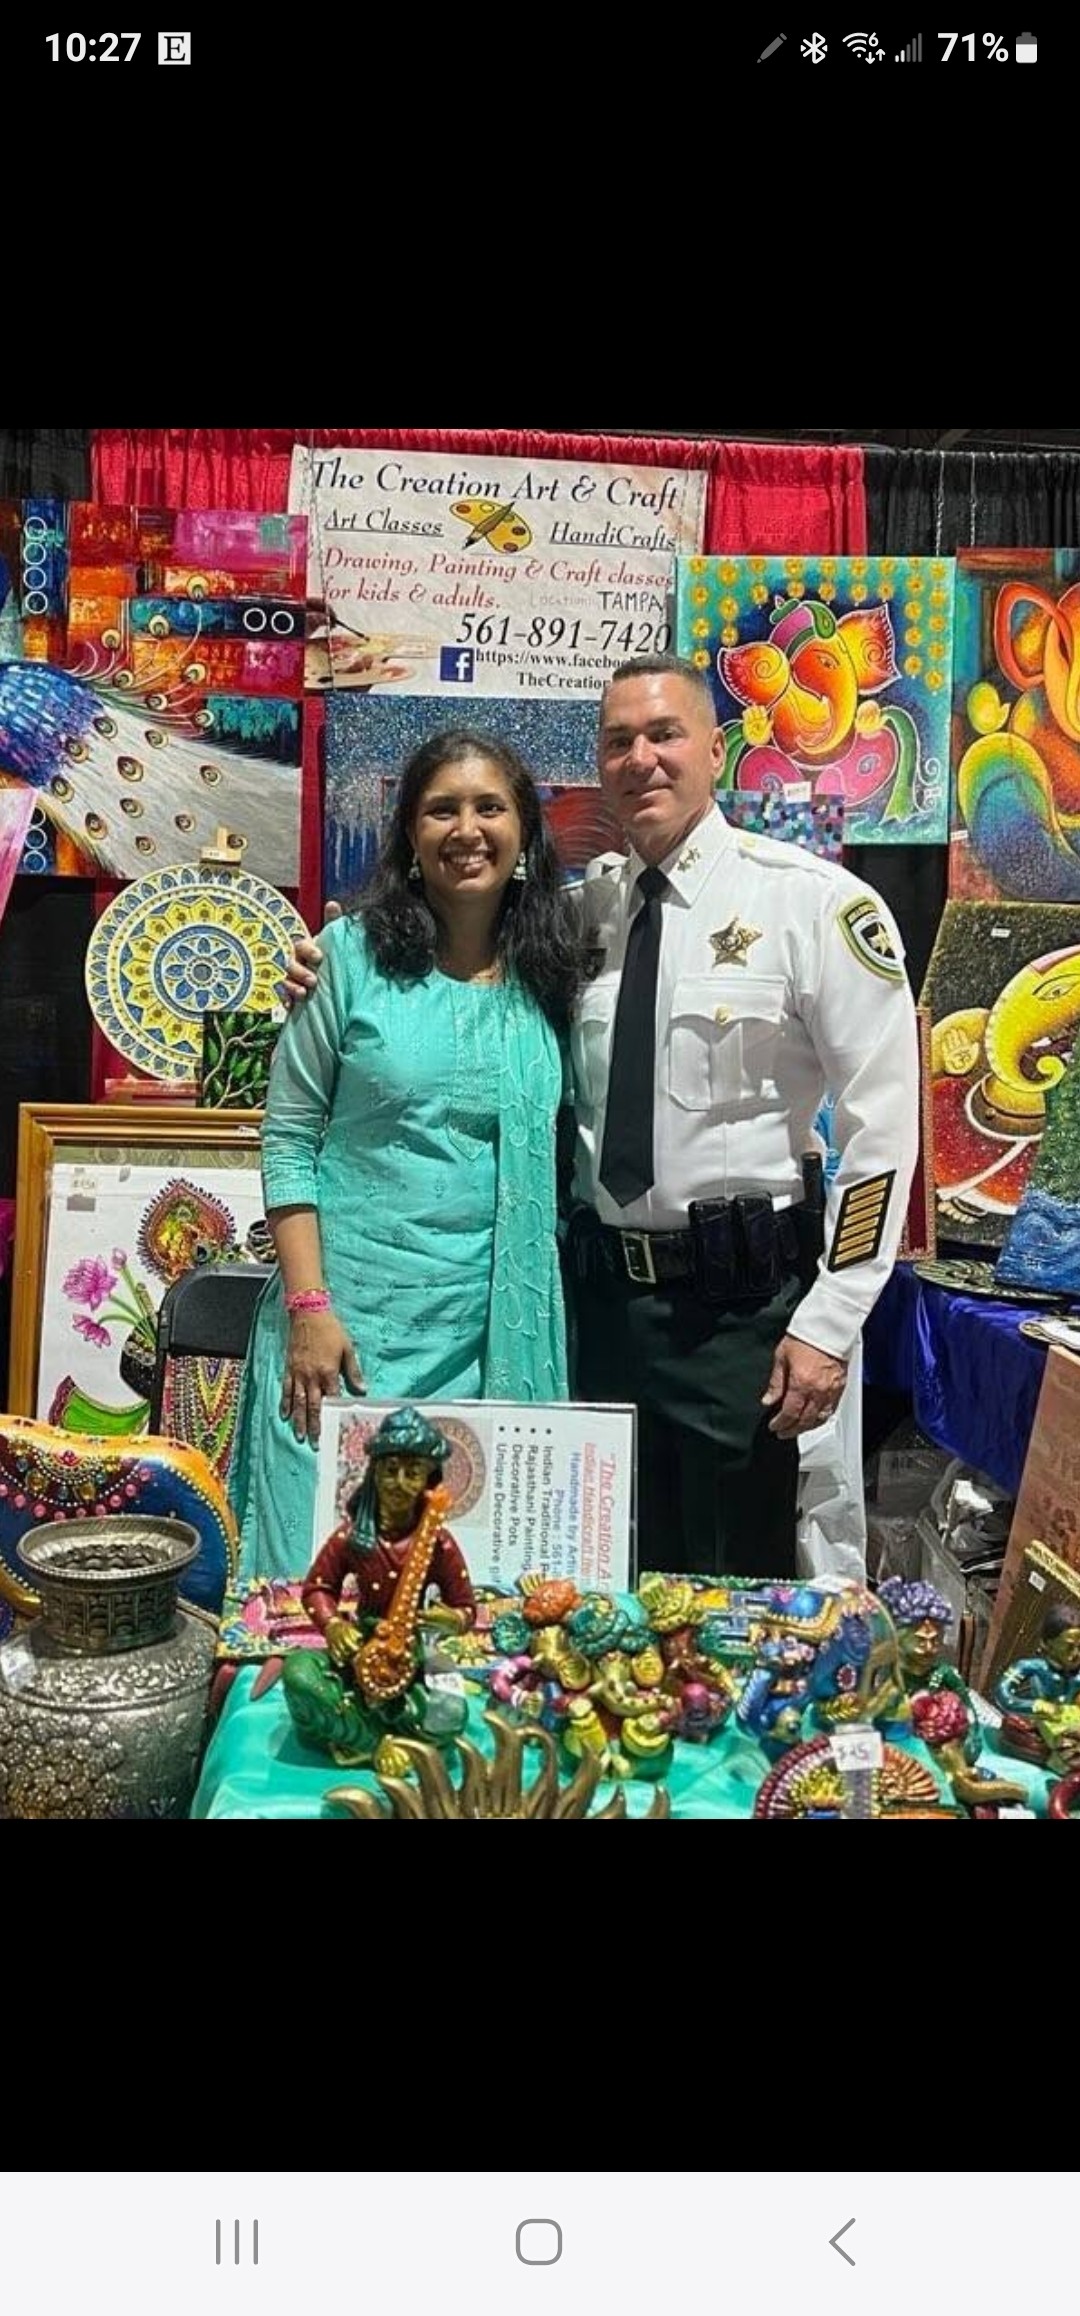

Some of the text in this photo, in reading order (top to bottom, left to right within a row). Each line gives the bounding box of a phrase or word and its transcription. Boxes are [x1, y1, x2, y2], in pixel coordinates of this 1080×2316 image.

[313, 457, 677, 516] The Creation Art & Craft
[324, 507, 444, 535] Art Classes
[550, 521, 676, 552] HandiCrafts
[325, 548, 674, 586] Drawing, Painting & Craft classes
[324, 576, 501, 609] for kids & adults.
[456, 612, 673, 654] 561-891-7420
[493, 1443, 507, 1489] Unique
[525, 1445, 538, 1514] Rajasthani
[542, 1446, 553, 1485] Indian
[570, 1452, 581, 1522] Handmade
[508, 1444, 523, 1547] Decorative Pots
[553, 1489, 564, 1531] Phone
[492, 1493, 506, 1562] Decorative
[540, 1491, 552, 1559] Traditional
[567, 1524, 578, 1540] by
[599, 1495, 615, 1563] Creation
